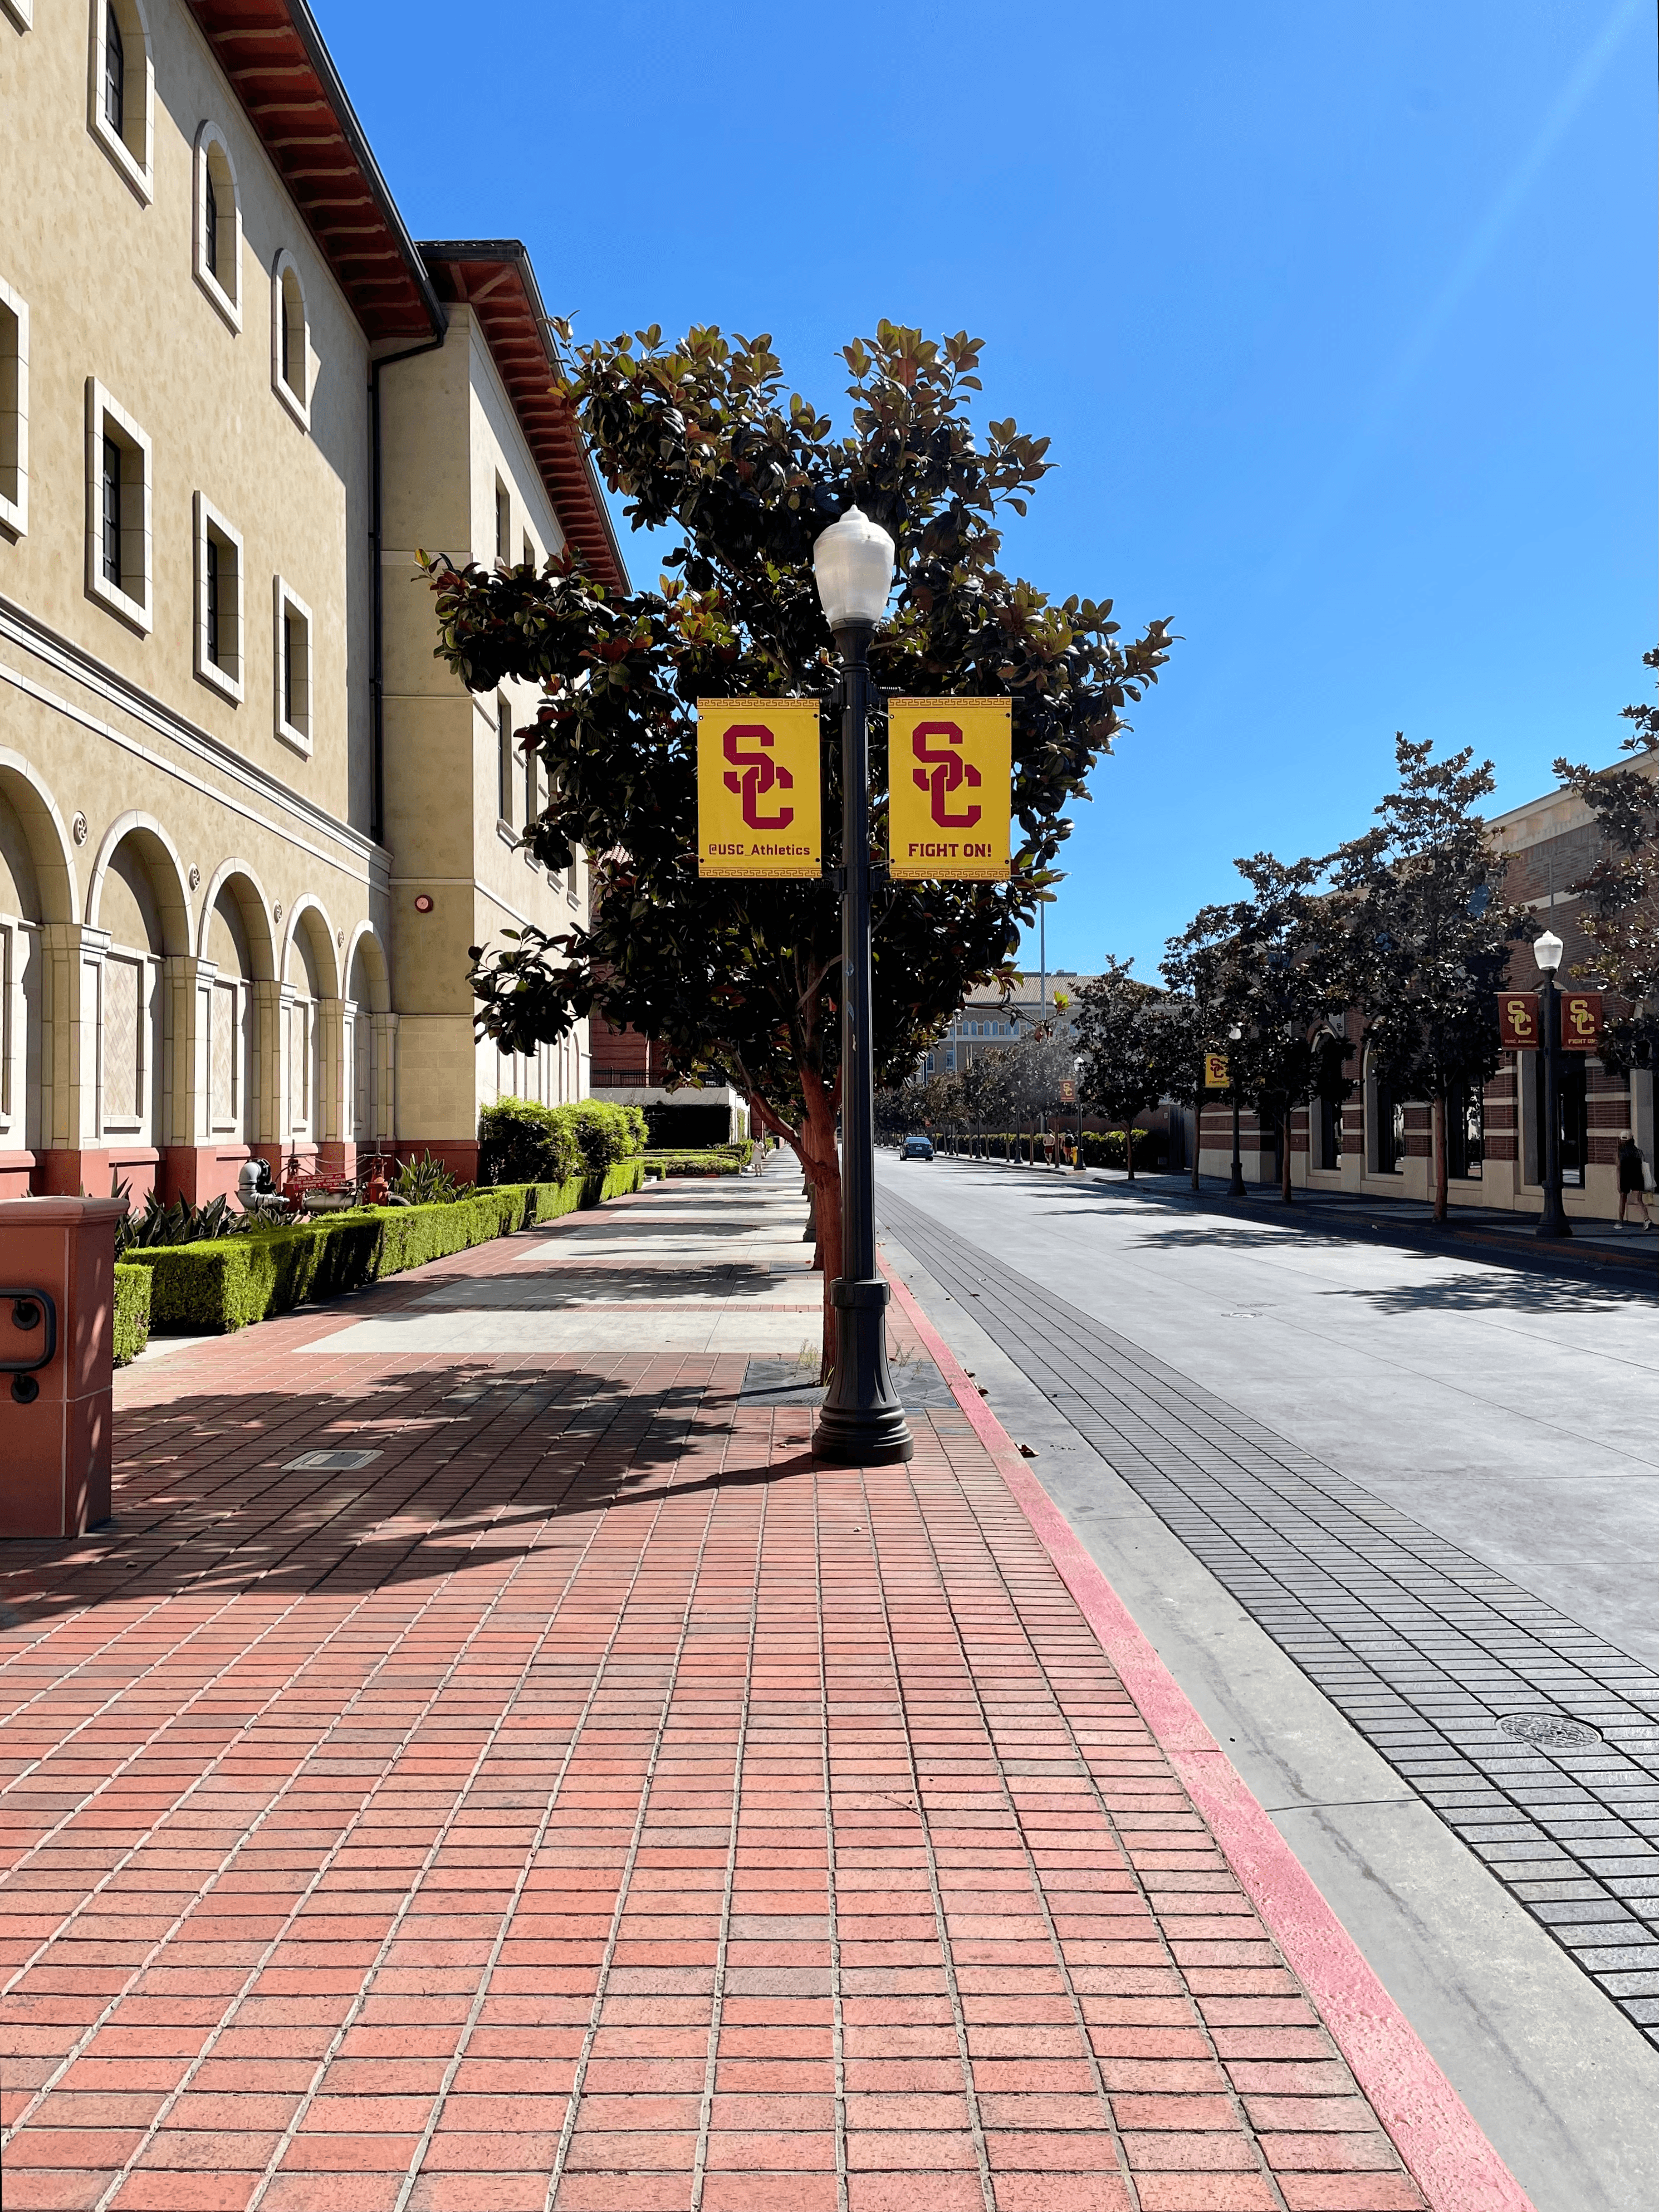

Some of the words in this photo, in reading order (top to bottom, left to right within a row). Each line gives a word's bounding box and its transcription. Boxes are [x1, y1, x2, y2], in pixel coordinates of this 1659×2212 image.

[723, 725, 794, 830] SC
[912, 722, 982, 828] SC
[708, 844, 810, 856] @USC_Athletics
[908, 843, 959, 857] FIGHT
[963, 843, 991, 857] ON!
[1508, 1000, 1531, 1035] SC
[1570, 1000, 1595, 1035] SC
